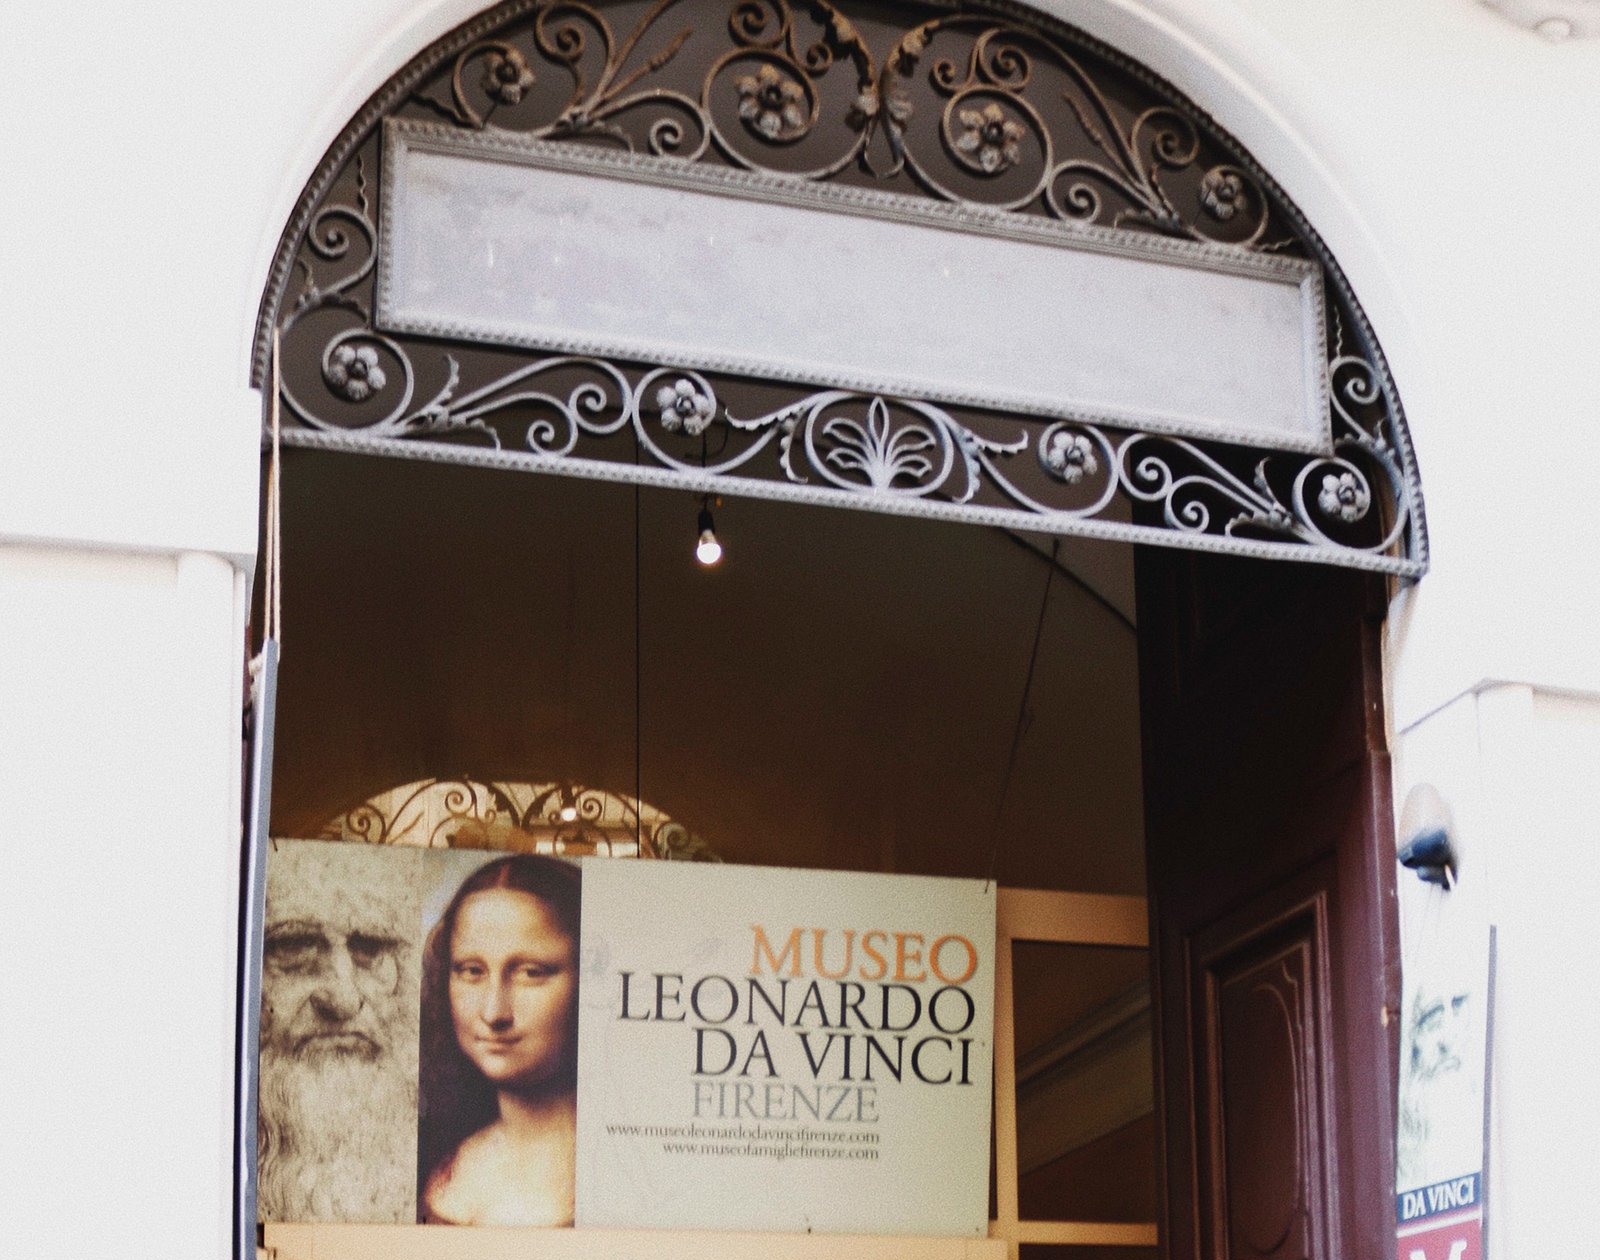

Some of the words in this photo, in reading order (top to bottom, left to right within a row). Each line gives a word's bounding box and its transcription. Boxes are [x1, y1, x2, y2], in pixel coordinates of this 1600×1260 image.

[750, 923, 979, 986] MUSEO
[617, 971, 976, 1035] LEONARDO
[692, 1027, 779, 1078] DA
[799, 1031, 975, 1086] VINCI
[692, 1081, 879, 1123] FIRENZE
[606, 1123, 880, 1144] www.museoleonardodavincifirenze.com
[1402, 1190, 1426, 1220] DA
[1427, 1176, 1475, 1213] VINCI
